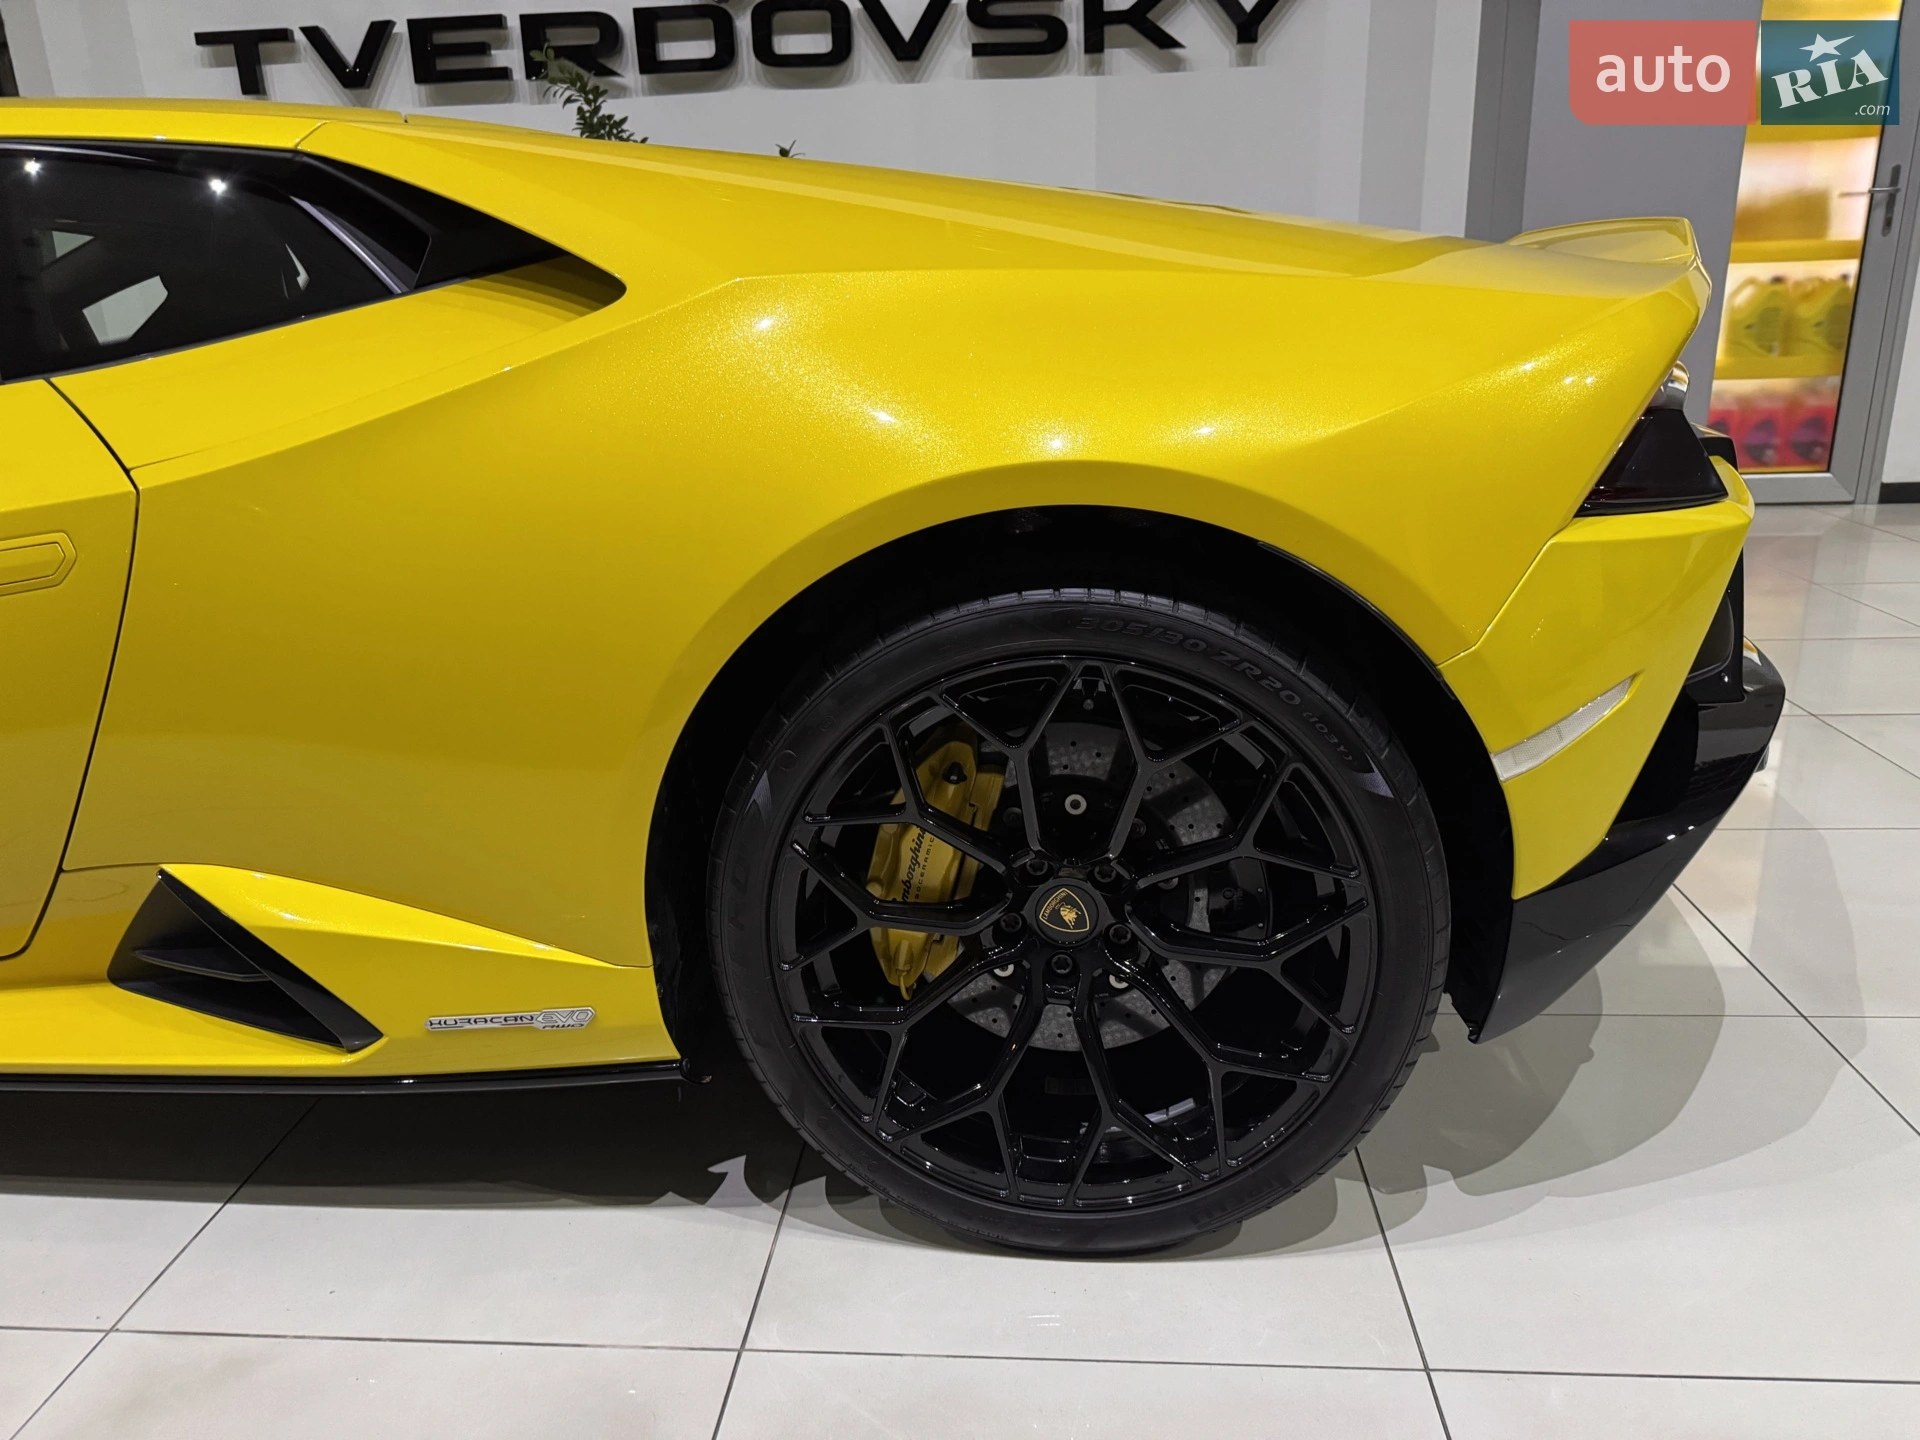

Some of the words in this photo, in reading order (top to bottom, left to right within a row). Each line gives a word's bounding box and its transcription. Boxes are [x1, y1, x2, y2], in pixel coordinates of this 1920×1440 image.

[194, 0, 1297, 96] TVERDOVSKY
[1076, 617, 1207, 651] 305/30
[1211, 651, 1301, 706] ZR20
[901, 826, 926, 903] mborghini
[914, 836, 935, 900] BOCERAMIC
[1042, 890, 1069, 921] LAMBORGHINI
[536, 1009, 594, 1023] EVO
